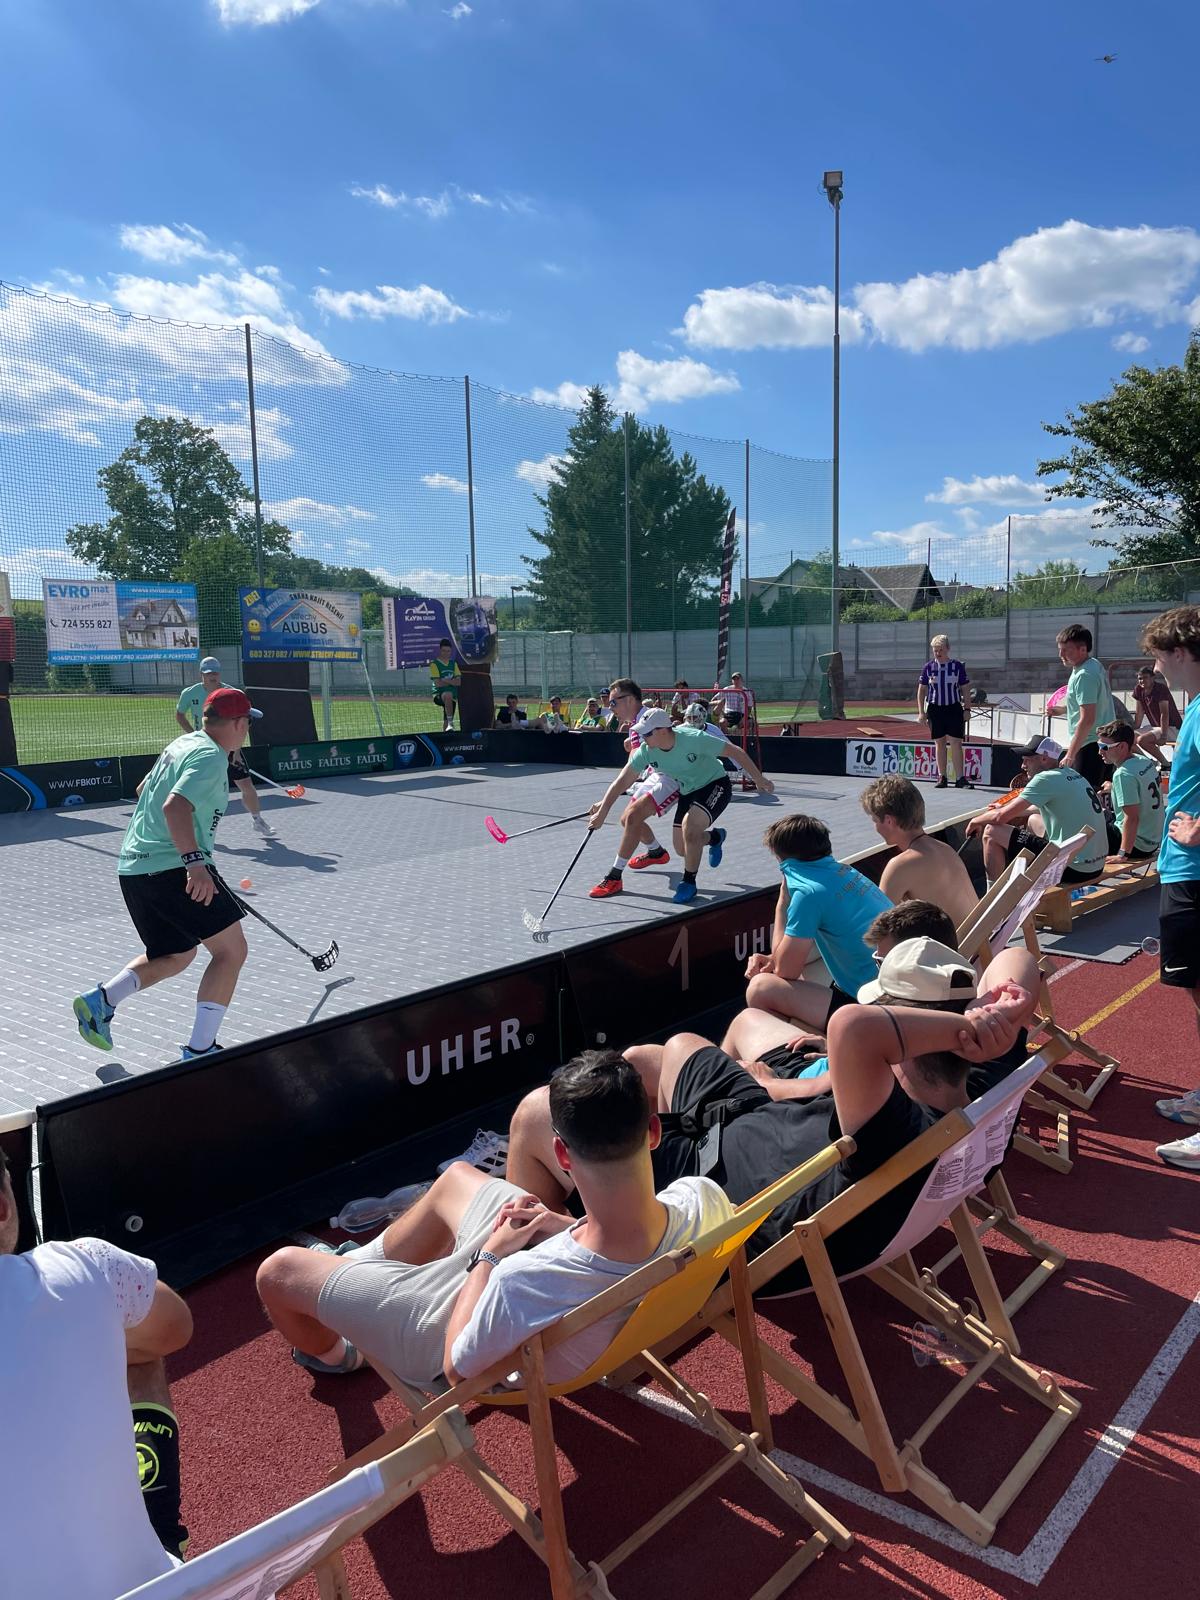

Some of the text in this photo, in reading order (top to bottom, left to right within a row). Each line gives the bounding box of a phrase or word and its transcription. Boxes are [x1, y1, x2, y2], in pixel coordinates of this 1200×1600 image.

[61, 619, 112, 629] 724 555 827
[282, 621, 328, 634] AUBUS
[357, 753, 388, 764] FALTUS
[854, 744, 876, 766] 10
[278, 760, 313, 771] FALTUS
[318, 756, 351, 768] FALTUS
[667, 926, 690, 992] 1
